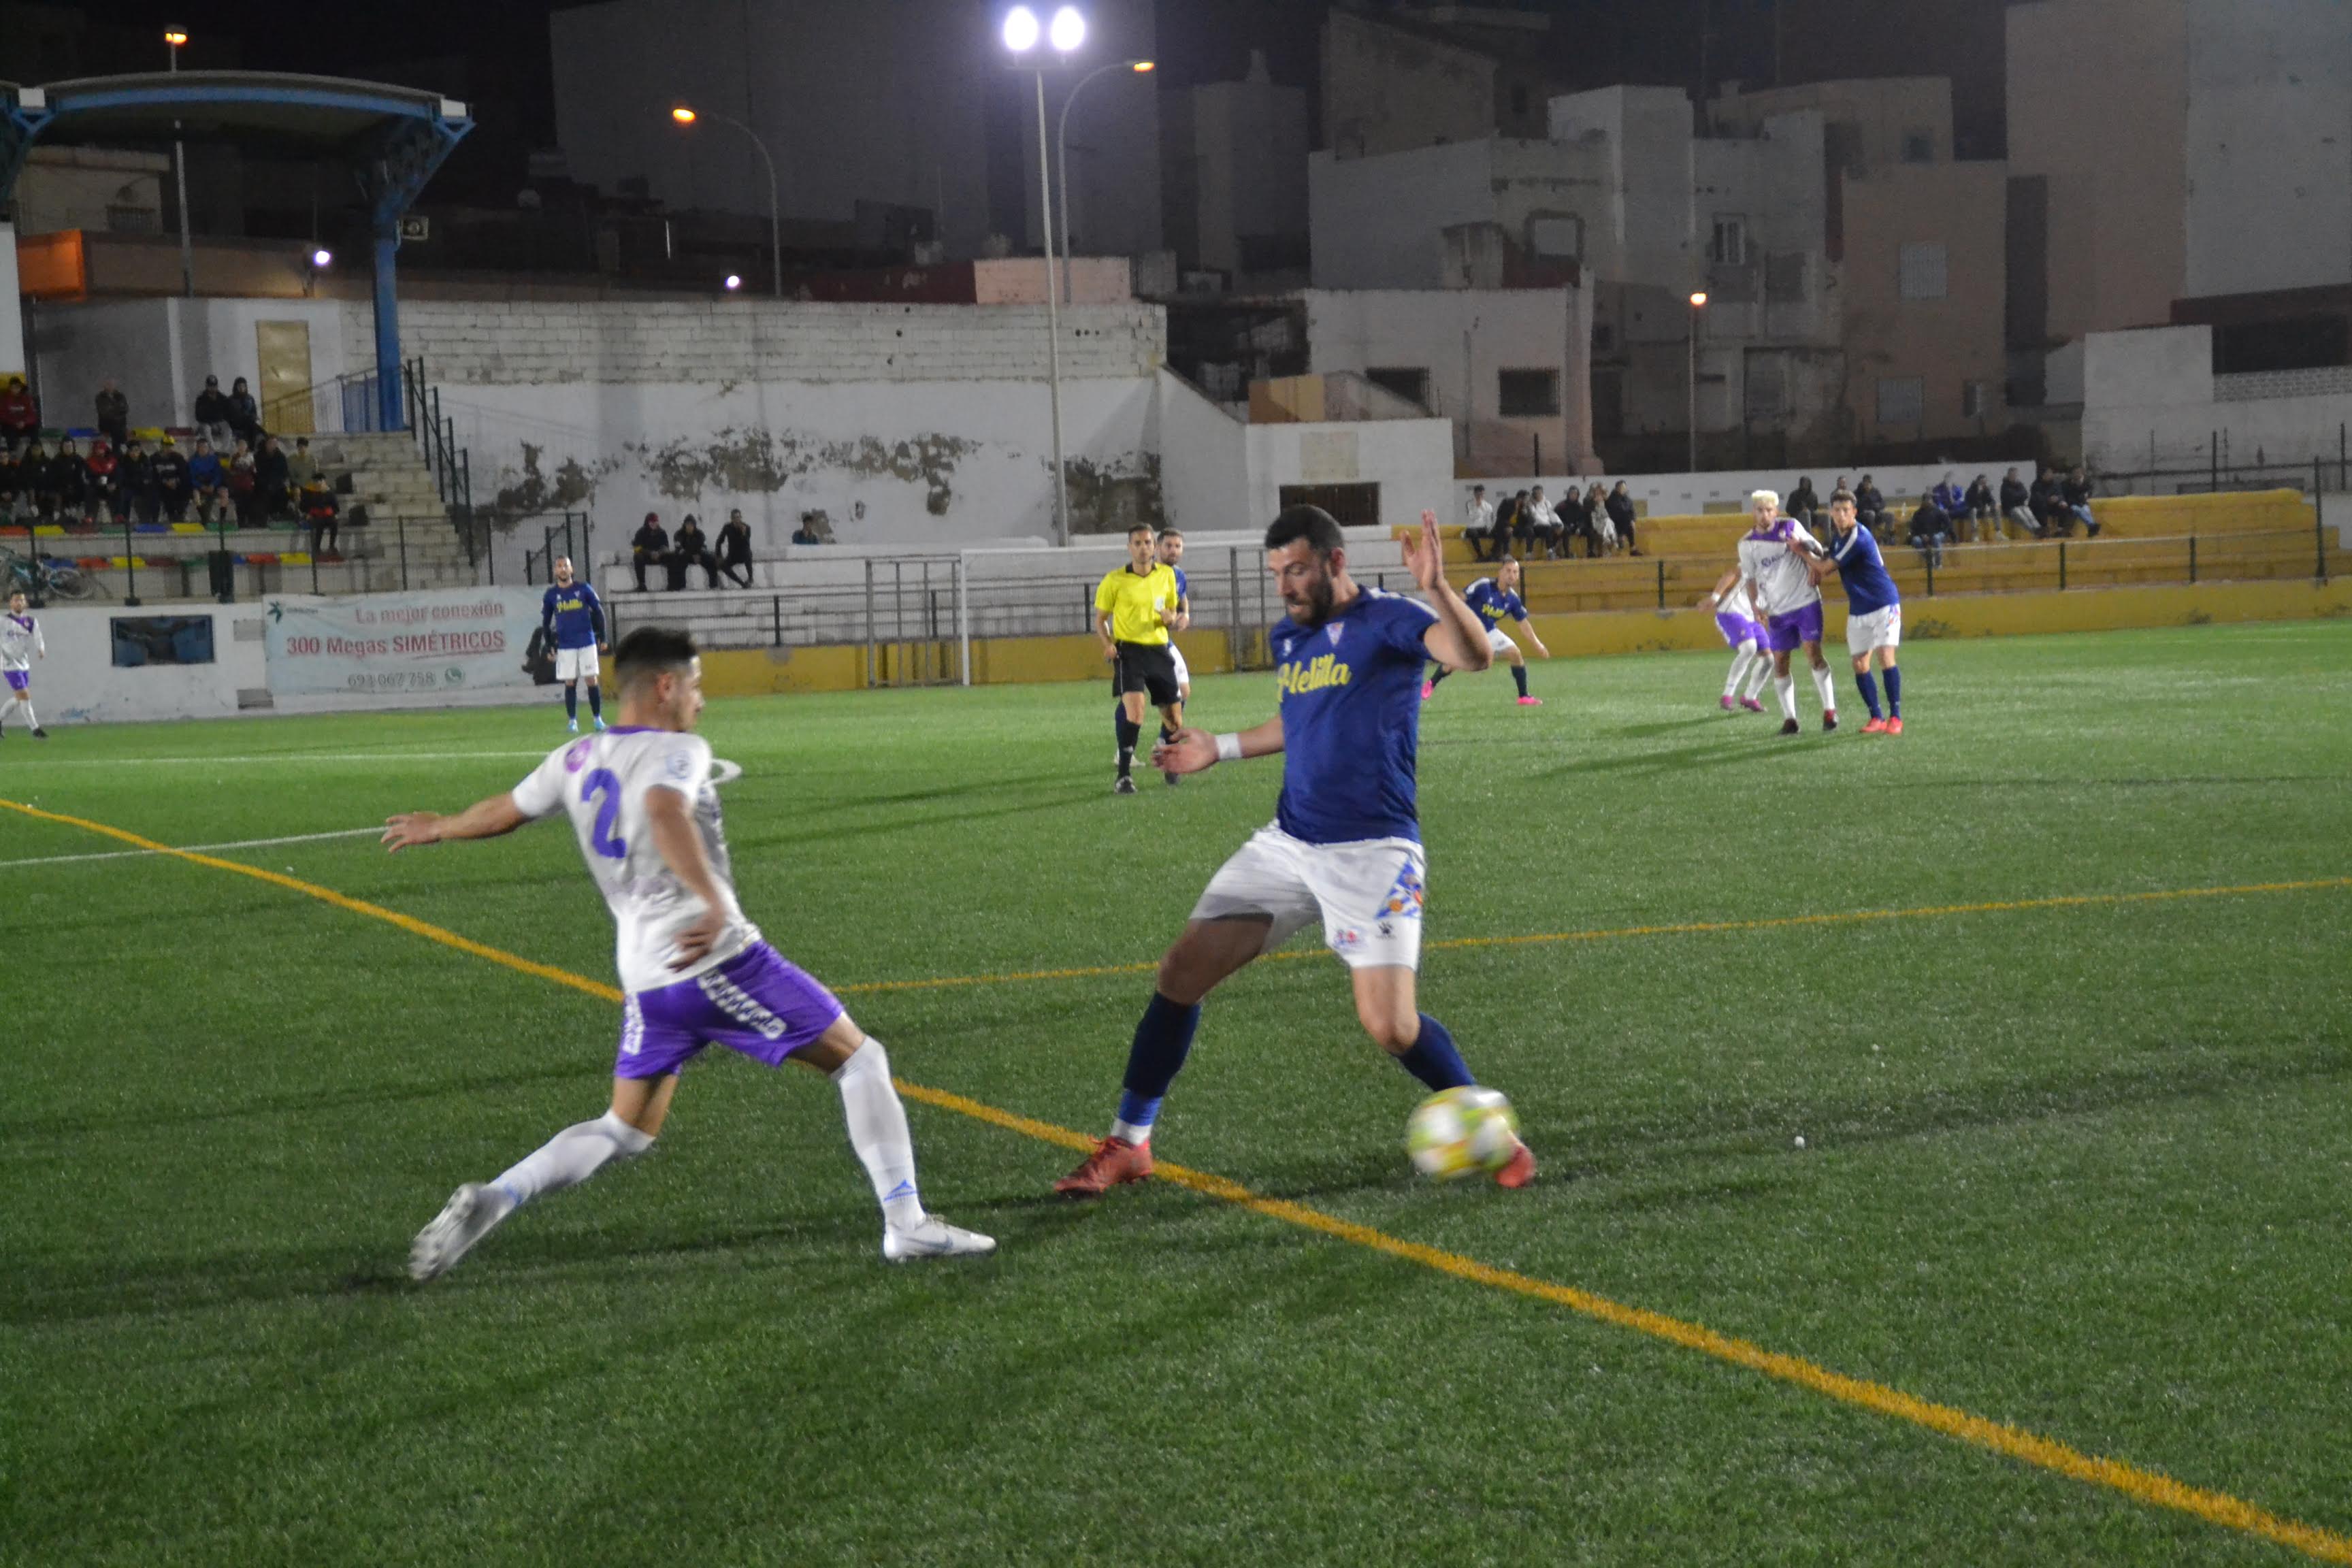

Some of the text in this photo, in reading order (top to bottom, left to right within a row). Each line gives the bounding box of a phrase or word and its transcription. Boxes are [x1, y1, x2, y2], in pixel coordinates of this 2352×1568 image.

[356, 598, 504, 624] La mejor conexión
[287, 629, 505, 660] 300 Megas SIMÉTRICOS
[581, 768, 627, 859] 2
